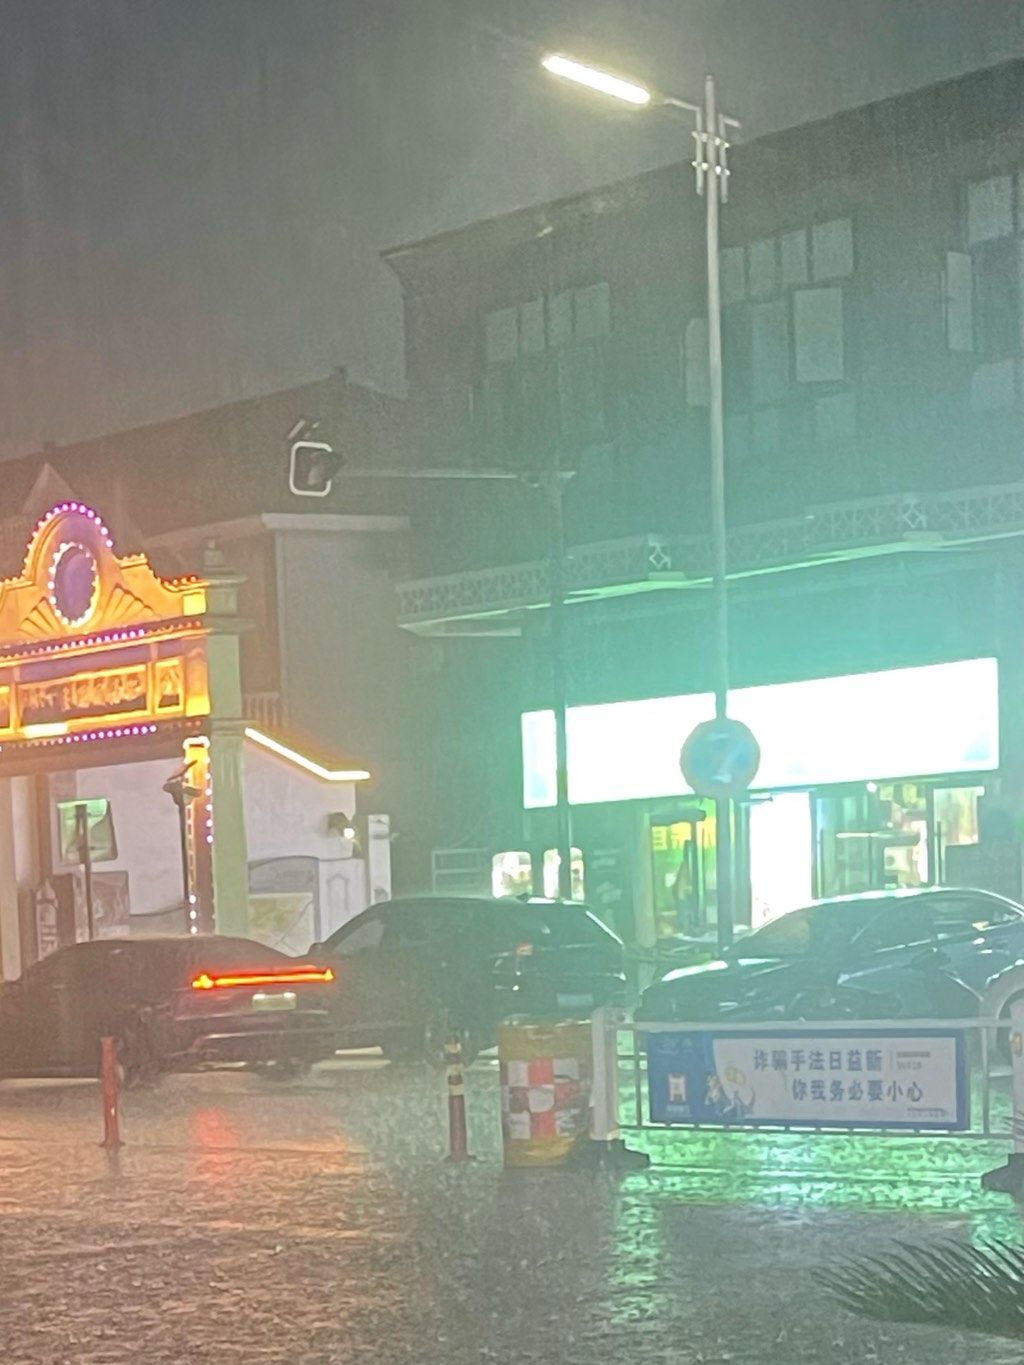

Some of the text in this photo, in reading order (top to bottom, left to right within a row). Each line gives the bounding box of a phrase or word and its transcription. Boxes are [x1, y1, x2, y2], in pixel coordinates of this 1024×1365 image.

[792, 1079, 923, 1102] 你我务必要小心
